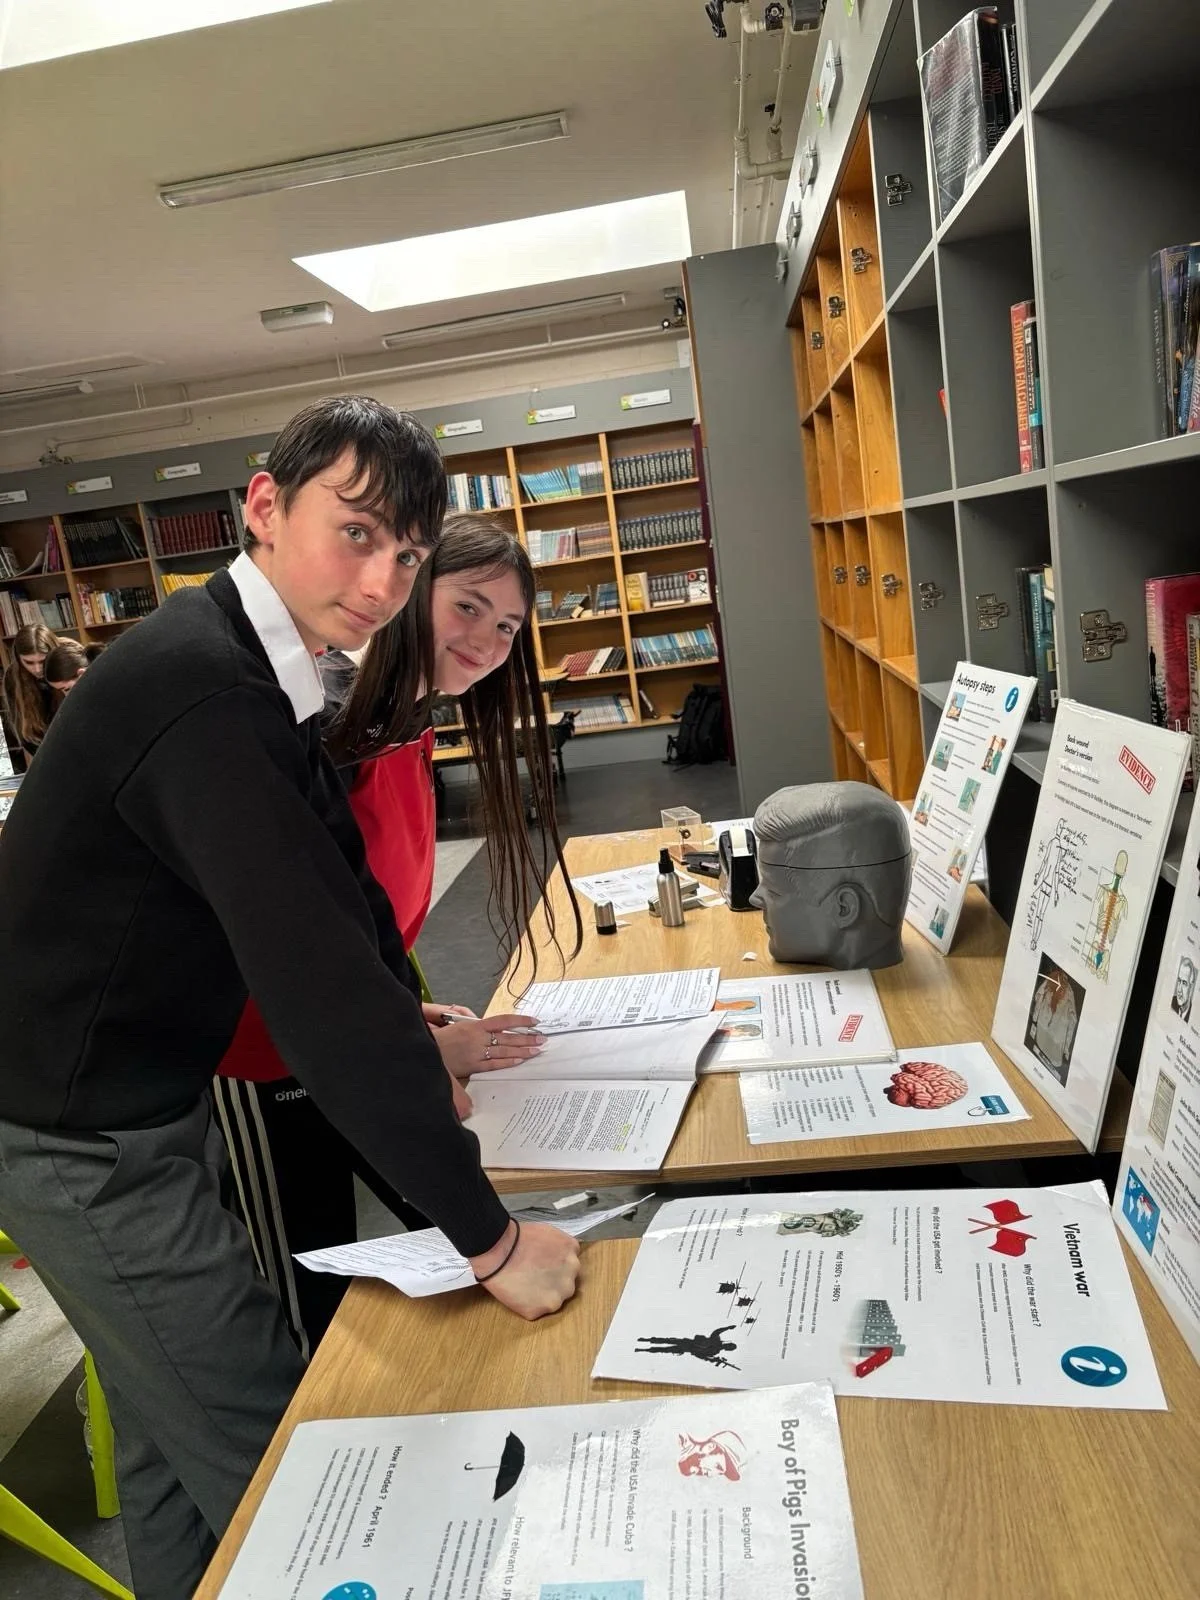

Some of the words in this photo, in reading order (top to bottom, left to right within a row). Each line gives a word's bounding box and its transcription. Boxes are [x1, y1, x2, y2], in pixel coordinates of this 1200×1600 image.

[1013, 318, 1026, 370] DUNCAN
[1016, 372, 1030, 432] FALCONER
[956, 672, 980, 693] Autopsy
[979, 680, 997, 697] steps
[1066, 734, 1076, 744] Back
[1075, 739, 1089, 748] wound
[1078, 752, 1093, 762] version
[1120, 749, 1155, 791] EVIDENCE
[931, 1240, 941, 1248] get
[933, 1230, 941, 1240] USA
[835, 1250, 843, 1259] Mid
[934, 1248, 942, 1270] involved
[1062, 1222, 1083, 1268] Vietnam
[1073, 1270, 1090, 1297] war
[1022, 1263, 1032, 1275] Why
[1025, 1275, 1034, 1285] did
[1026, 1286, 1035, 1296] the
[1028, 1296, 1036, 1307] war
[1030, 1308, 1040, 1322] start
[630, 1428, 641, 1446] Why
[777, 1418, 799, 1452] Bay
[391, 1445, 403, 1462] How
[630, 1446, 640, 1459] did
[629, 1460, 639, 1473] the
[784, 1456, 806, 1475] of
[380, 1469, 393, 1494] ended
[628, 1474, 638, 1492] USA
[781, 1478, 807, 1517] Pigs
[369, 1505, 382, 1525] April
[513, 1516, 525, 1536] How
[624, 1522, 635, 1545] Cuba
[740, 1506, 754, 1559] Background
[361, 1527, 375, 1547] 1961
[505, 1537, 520, 1573] relevant
[503, 1575, 514, 1585] to
